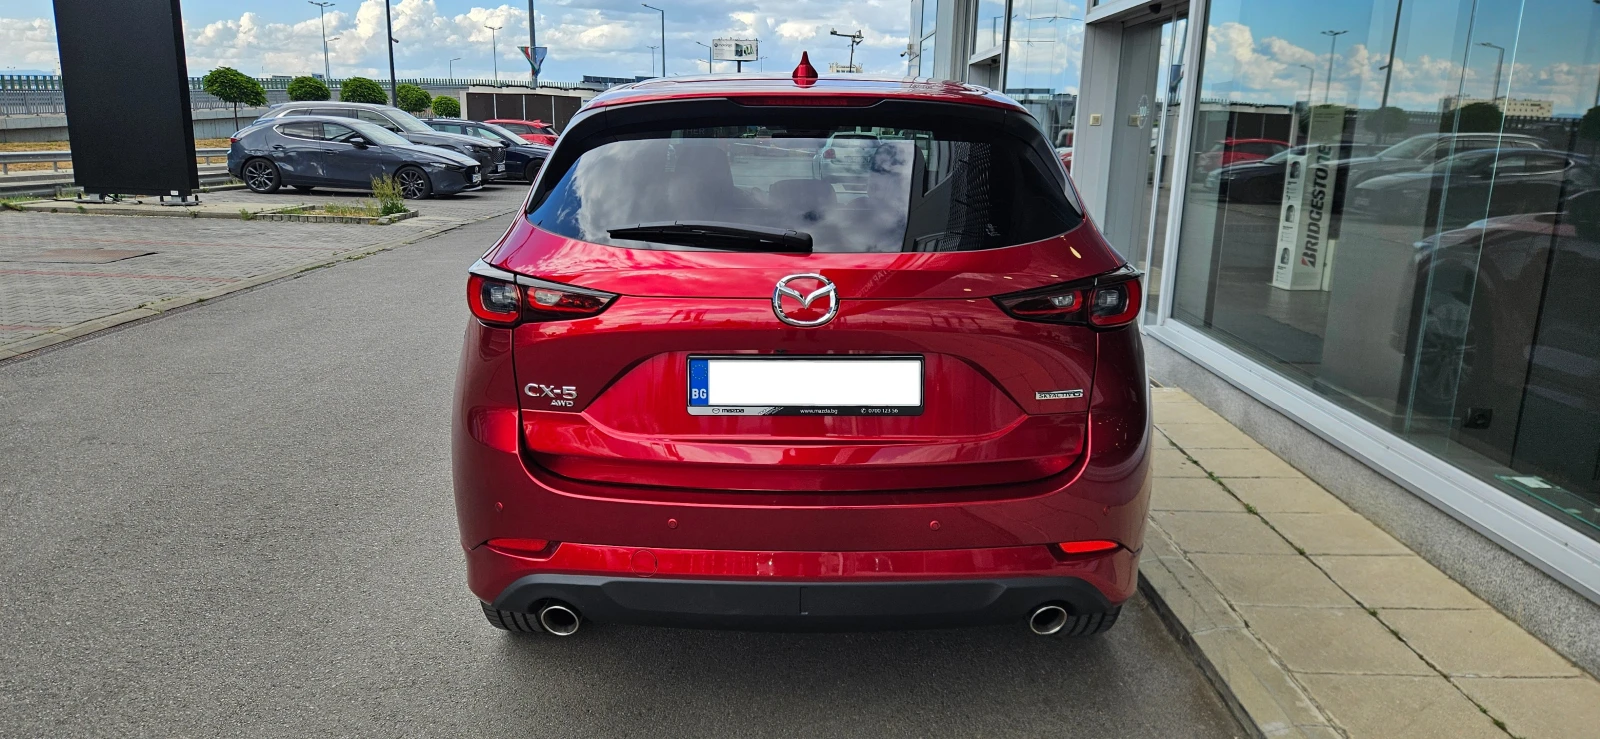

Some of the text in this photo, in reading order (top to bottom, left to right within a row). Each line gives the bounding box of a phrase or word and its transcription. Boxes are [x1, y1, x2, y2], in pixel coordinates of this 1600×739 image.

[1301, 144, 1332, 268] BRIDGESTONE
[524, 383, 577, 399] CX-5
[692, 388, 707, 399] BG
[550, 399, 574, 407] AWD
